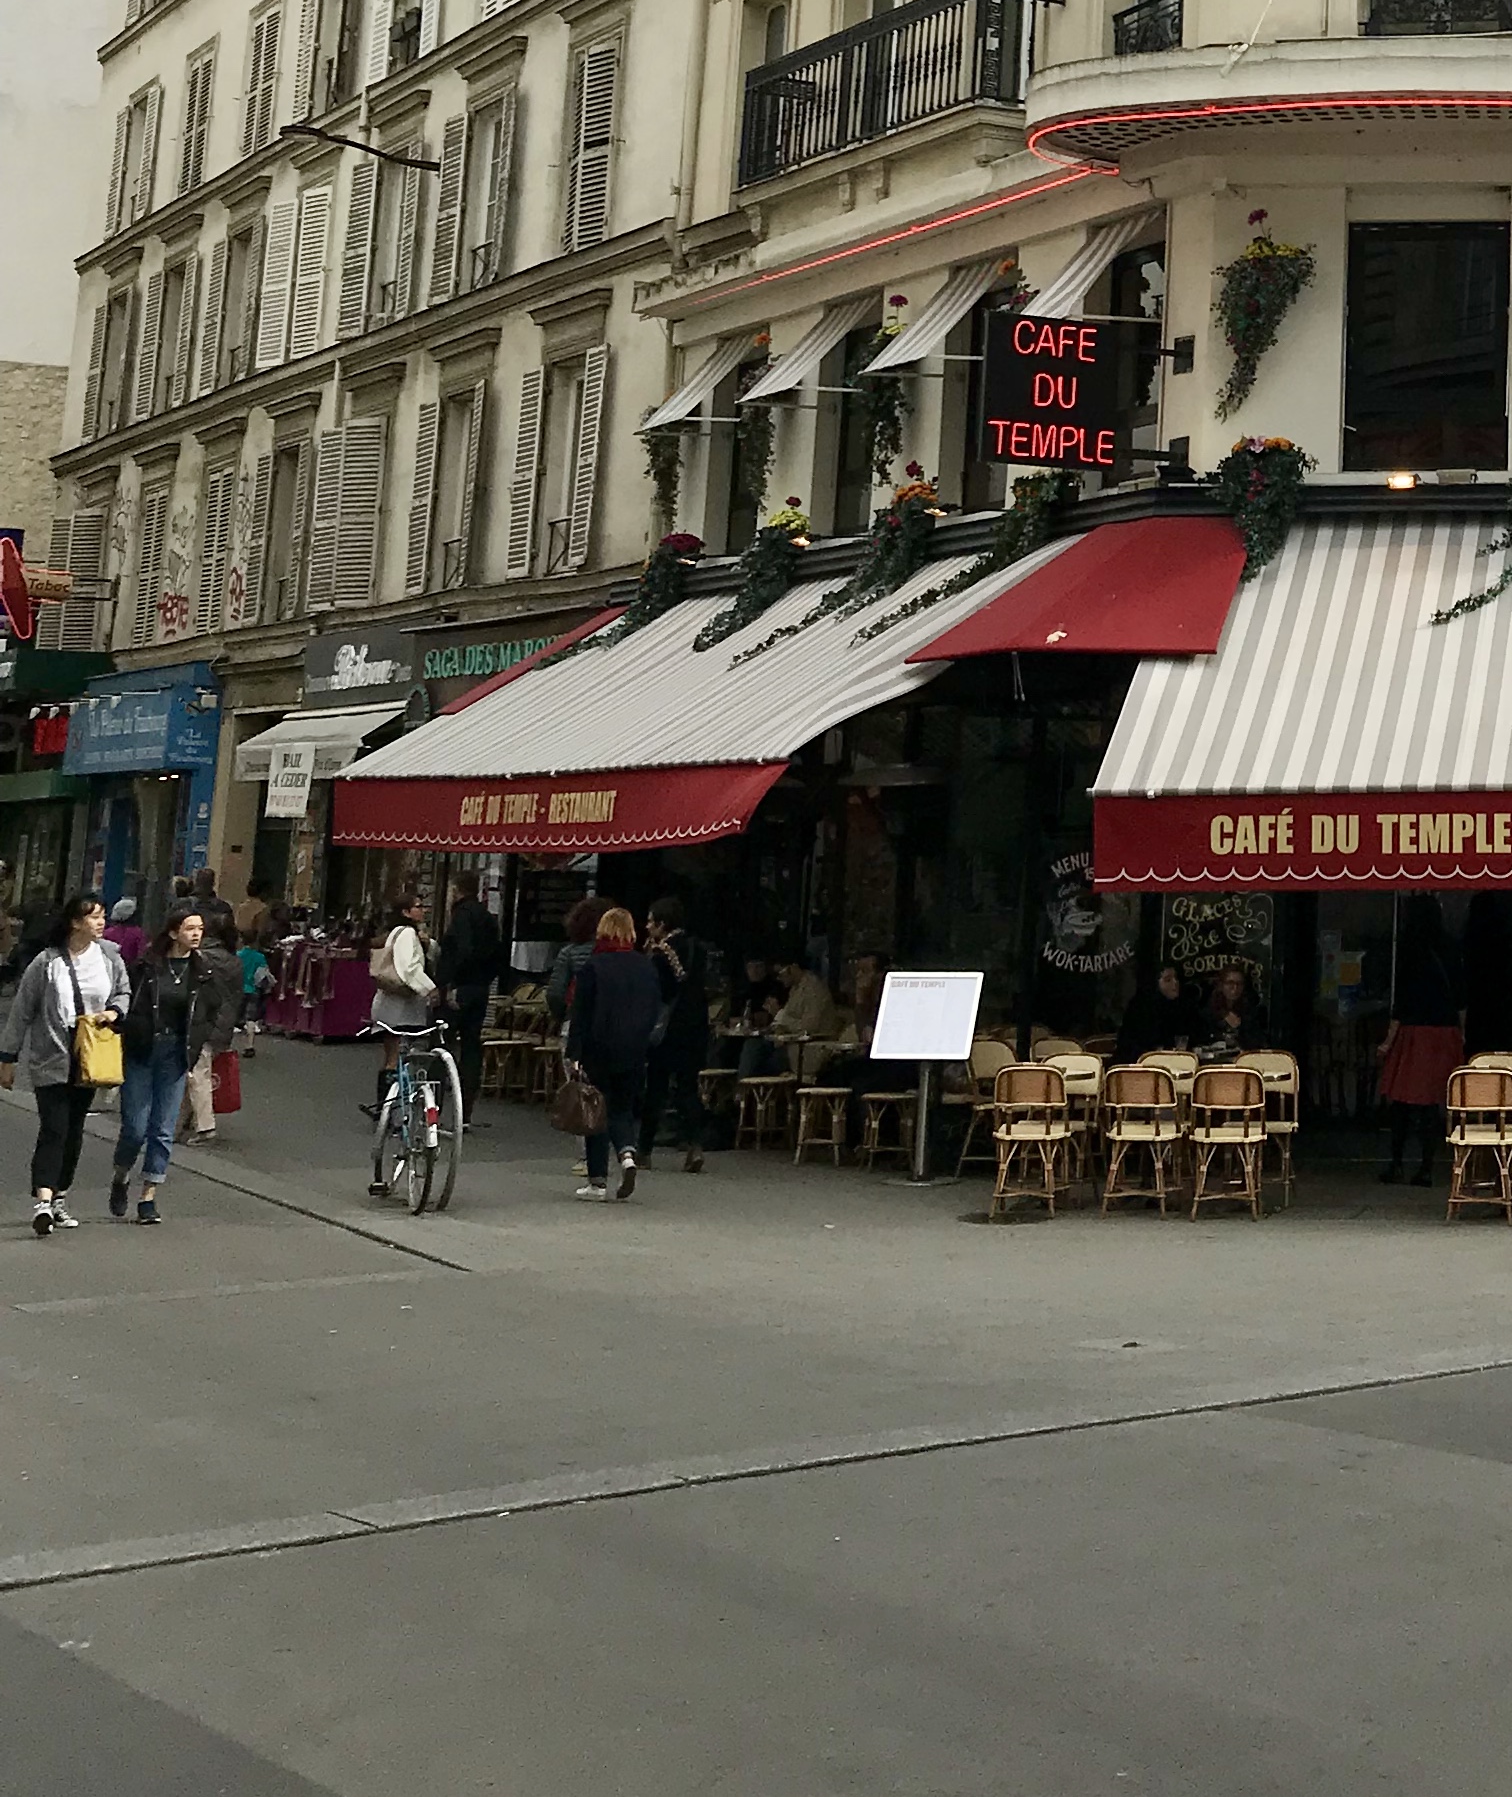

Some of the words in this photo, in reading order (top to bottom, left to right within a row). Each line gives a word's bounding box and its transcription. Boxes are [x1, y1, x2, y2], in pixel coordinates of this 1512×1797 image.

[1014, 320, 1097, 362] CAFE
[1034, 373, 1077, 409] DU
[987, 420, 1115, 464] TEMPLE
[28, 578, 71, 592] Tabac
[423, 647, 460, 679] SAGA
[462, 644, 494, 674] DES
[460, 790, 486, 826] CAFÉ
[485, 795, 501, 826] DU
[502, 793, 540, 824] TEMPLE
[548, 790, 617, 824] RESTAURANT
[1209, 807, 1294, 855] CAFÉ
[1311, 814, 1360, 854] DU
[1376, 813, 1512, 854] TEMPLE
[1050, 852, 1089, 878] MENU
[1171, 894, 1242, 922] GLACES
[1042, 941, 1135, 973] WOK-TARTARE
